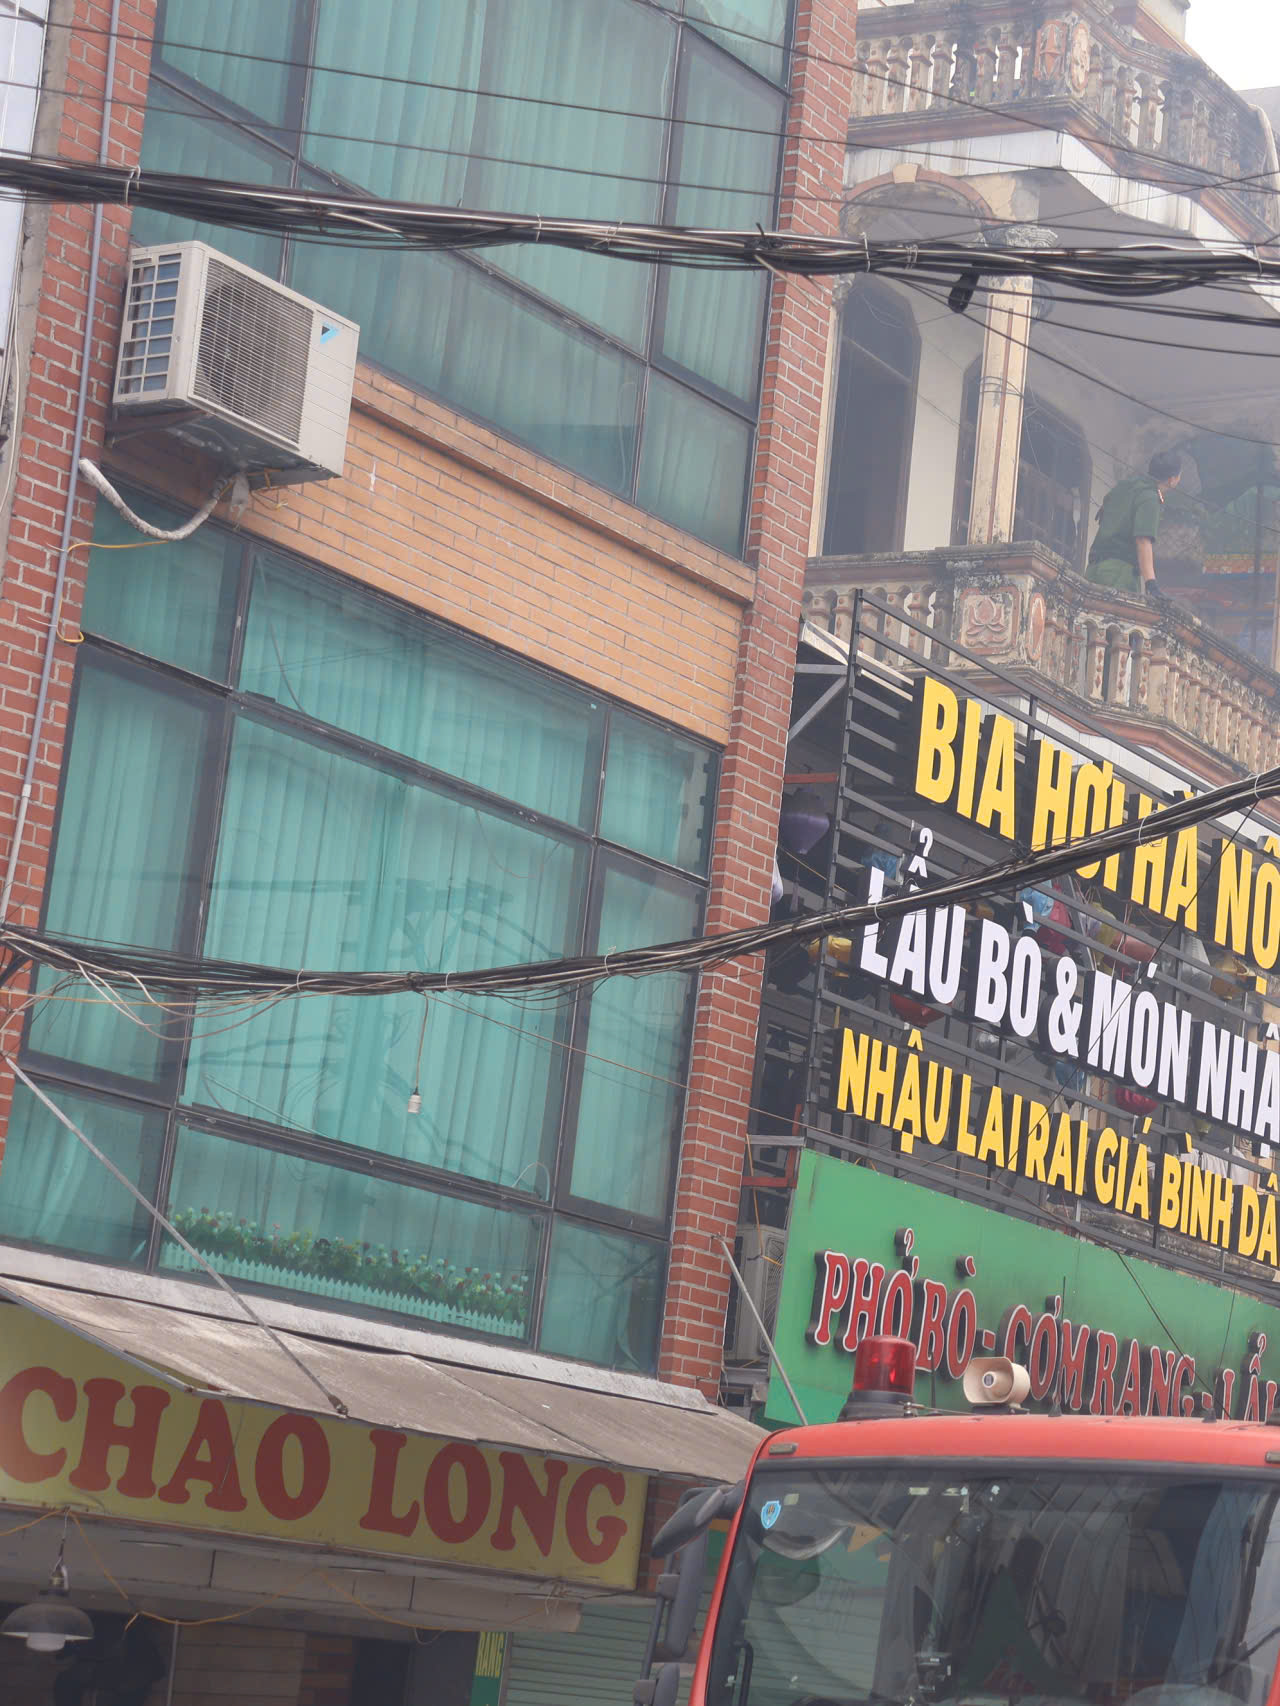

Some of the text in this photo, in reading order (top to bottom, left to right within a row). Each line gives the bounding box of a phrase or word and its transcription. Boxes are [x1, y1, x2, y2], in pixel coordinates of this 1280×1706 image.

[915, 676, 1015, 840] BIA
[1031, 739, 1125, 892] HƠI
[860, 828, 967, 1005] LẨU
[974, 904, 1042, 1037] BÒ
[1048, 956, 1083, 1058] &
[1087, 962, 1191, 1102] MÓN
[836, 1028, 952, 1153] NHẬU
[956, 1073, 1023, 1171] LAI
[1025, 1113, 1087, 1196] RAI
[1094, 1117, 1153, 1220] GIÁ
[1160, 1132, 1234, 1250] BÌNH
[815, 1228, 919, 1353] PHỞ
[916, 1256, 978, 1379] BÒ
[1004, 1295, 1091, 1411] CƠM
[1090, 1330, 1196, 1417] RANG
